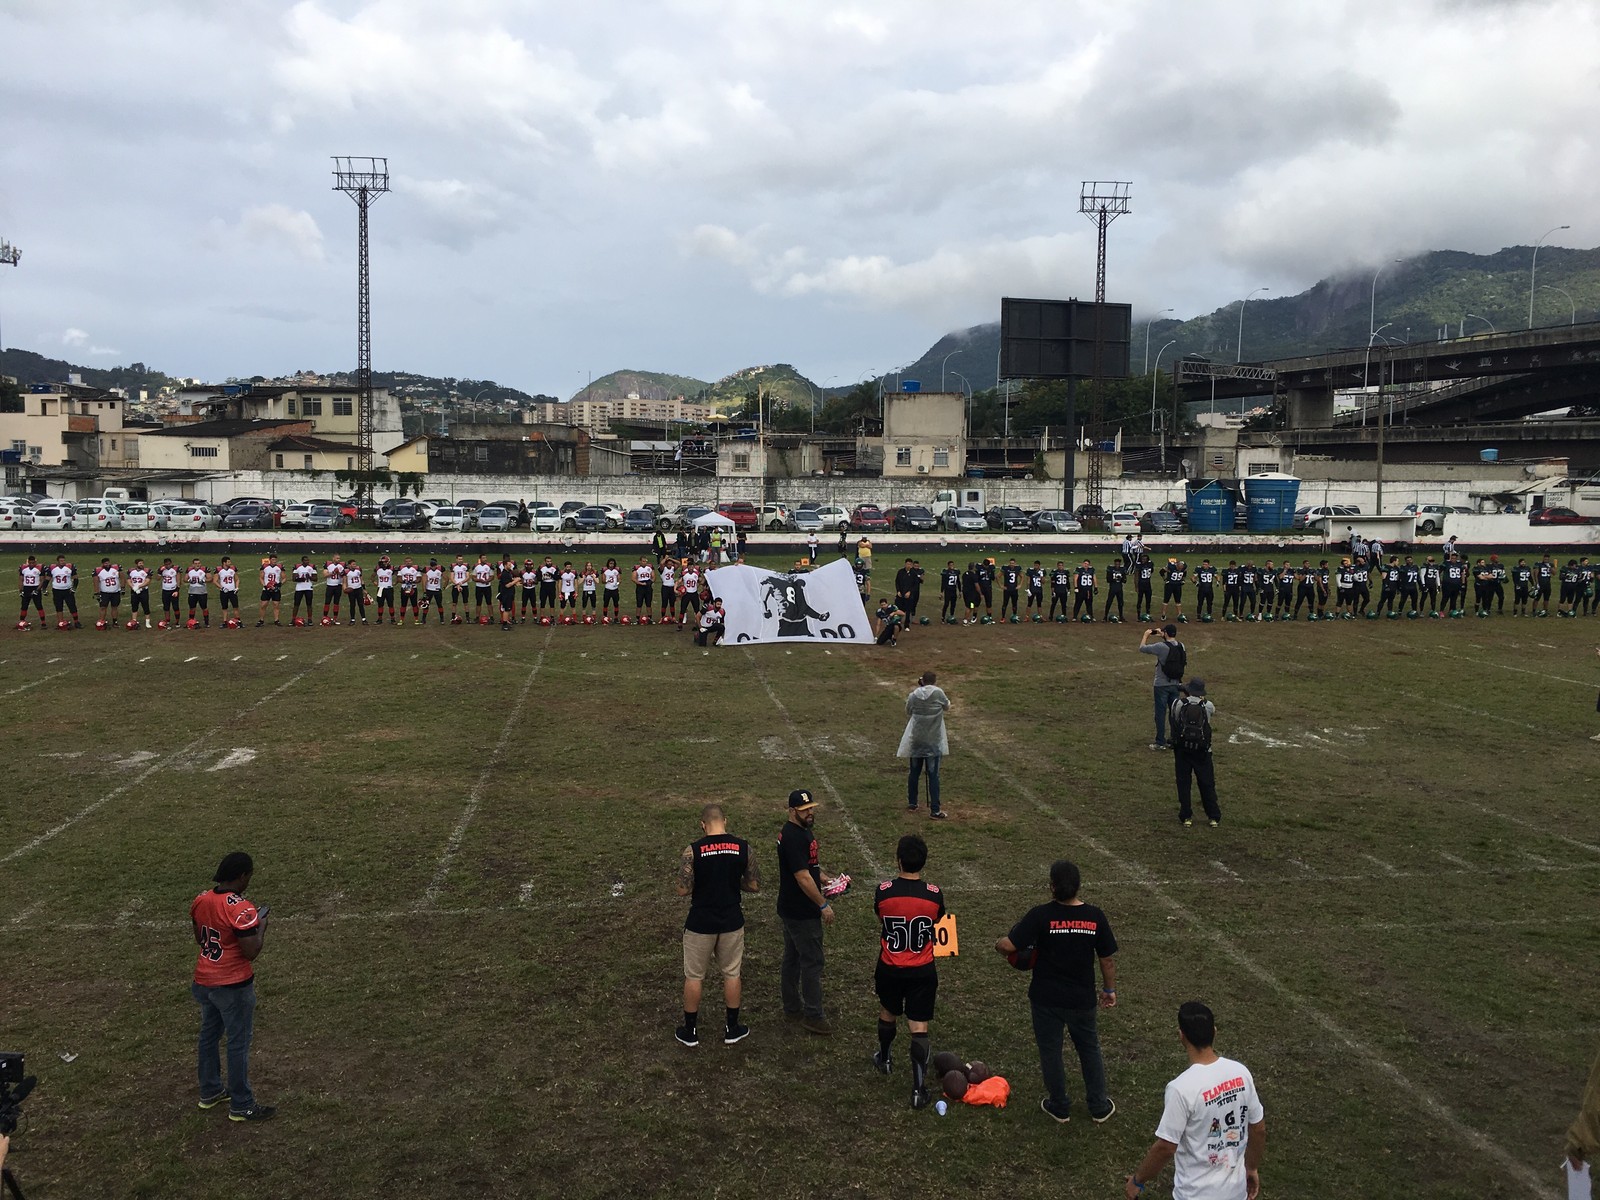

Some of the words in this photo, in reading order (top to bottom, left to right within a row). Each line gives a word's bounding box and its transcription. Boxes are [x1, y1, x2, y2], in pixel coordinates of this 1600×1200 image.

[55, 575, 67, 584] 64
[104, 577, 117, 587] 95
[948, 575, 958, 586] 21
[1009, 572, 1016, 583] 3
[1056, 574, 1067, 585] 36
[1080, 575, 1093, 586] 66
[1200, 573, 1213, 583] 58
[1227, 574, 1238, 584] 27
[700, 843, 740, 853] FLAMENGO
[1050, 921, 1097, 930] FLAMENGO
[883, 915, 933, 954] 56
